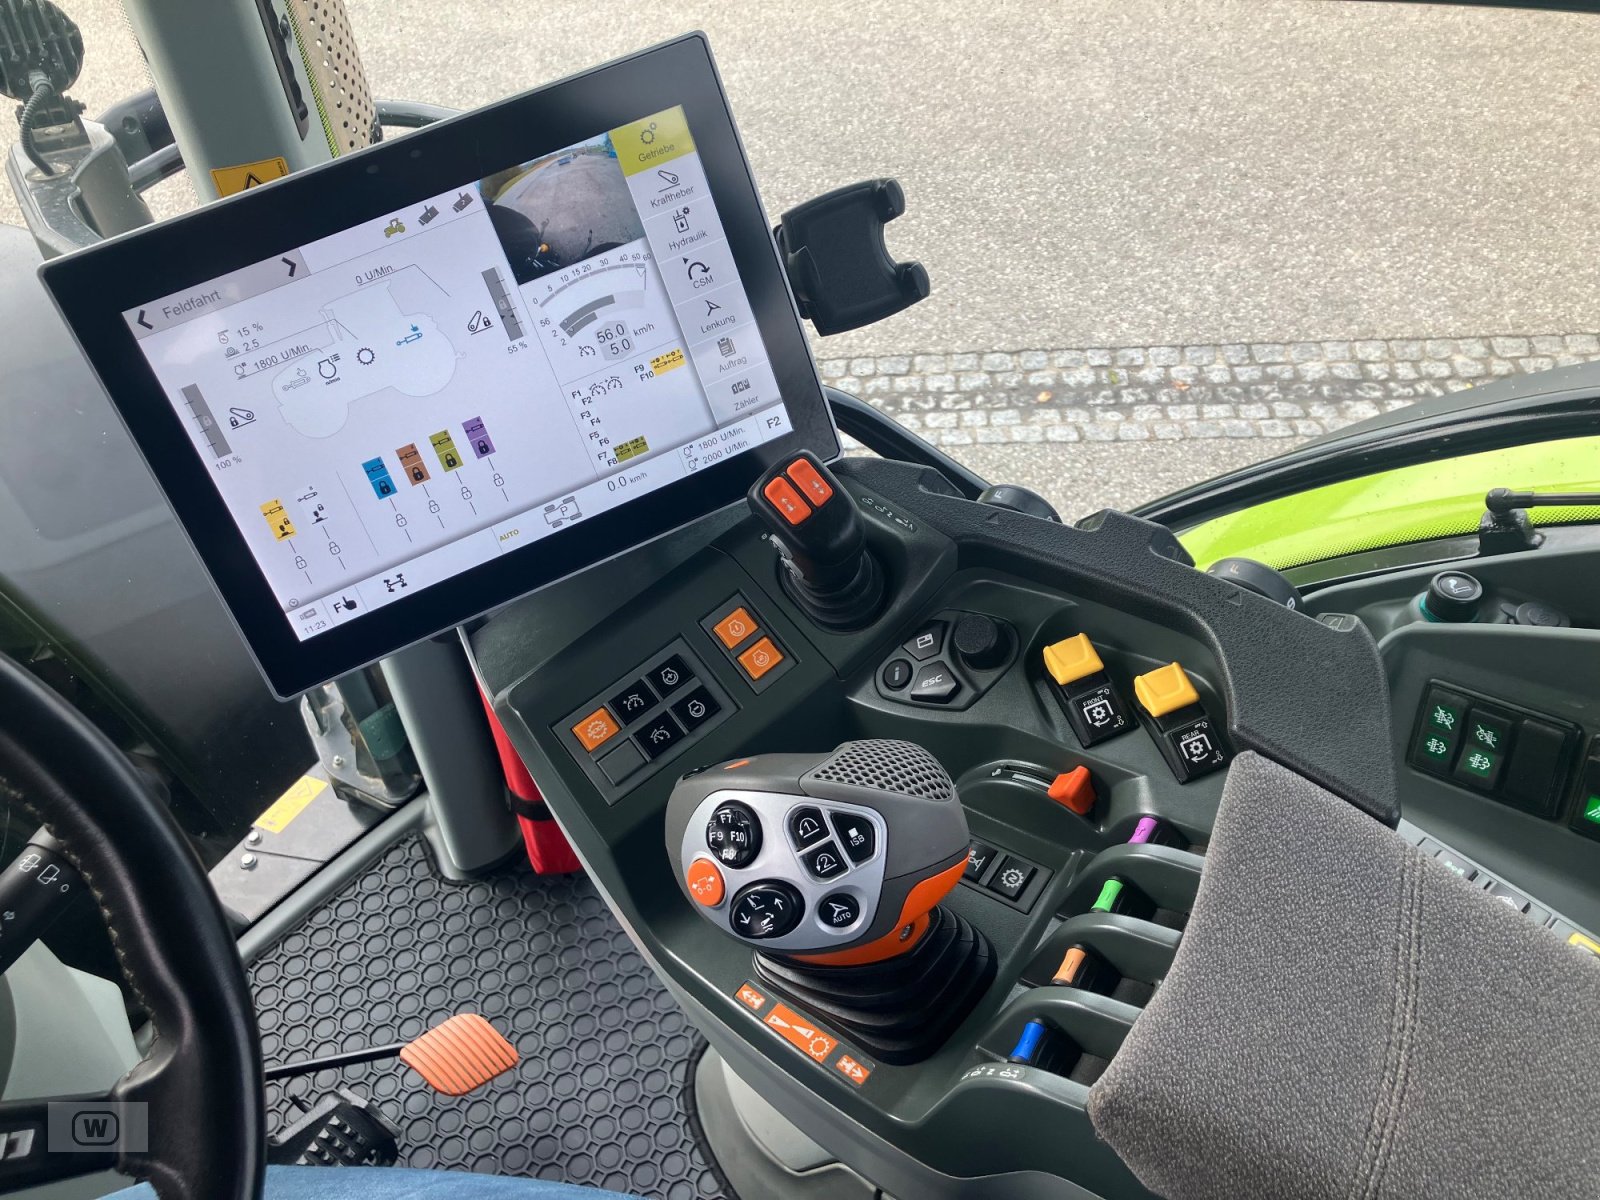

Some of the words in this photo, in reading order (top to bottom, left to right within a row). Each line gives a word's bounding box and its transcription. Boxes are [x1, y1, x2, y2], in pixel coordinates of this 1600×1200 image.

[638, 143, 675, 162] Getriebe
[650, 186, 694, 208] Kraftheber
[668, 230, 708, 251] Hydraulik
[599, 258, 609, 267] 30
[619, 253, 629, 262] 40
[632, 252, 641, 261] 50
[642, 253, 652, 262] 60
[572, 269, 581, 277] 15
[582, 264, 592, 273] 20
[355, 275, 363, 285] 0
[560, 275, 570, 283] 10
[692, 275, 714, 289] CSM
[162, 290, 222, 319] Feldfahrt
[540, 318, 551, 327] 56
[700, 315, 736, 334] Lenkung
[237, 327, 250, 338] 15
[252, 322, 264, 332] %
[596, 323, 625, 344] 56.0
[632, 323, 655, 337] km/h
[243, 339, 260, 351] 2.5
[507, 344, 519, 354] 55
[518, 341, 528, 350] %
[610, 338, 631, 355] 5.0
[254, 355, 278, 371] 1800
[634, 364, 645, 374] F9
[719, 356, 748, 373] Auftrag
[639, 370, 655, 382] F10
[571, 390, 582, 399] F1
[581, 396, 592, 406] F2
[580, 410, 591, 420] F3
[590, 417, 601, 426] F4
[766, 416, 782, 429] F2
[588, 431, 600, 441] F5
[598, 437, 610, 447] F6
[698, 437, 718, 450] 1800
[597, 451, 608, 461] F7
[703, 451, 723, 464] 2000
[215, 459, 232, 471] 100
[232, 456, 243, 465] %
[607, 458, 618, 467] F8
[607, 476, 627, 492] 0.0
[629, 472, 648, 484] km/h
[499, 529, 520, 542] AUTO
[304, 620, 327, 634] 11:23
[922, 674, 943, 688] ESC
[1082, 694, 1104, 707] FRONT
[1181, 729, 1200, 741] REAR
[720, 814, 732, 824] F7
[803, 821, 812, 833] 1
[709, 831, 724, 842] F9
[730, 831, 745, 842] F10
[850, 834, 865, 847] ISB
[820, 855, 830, 867] 2
[832, 911, 852, 924] AUTO
